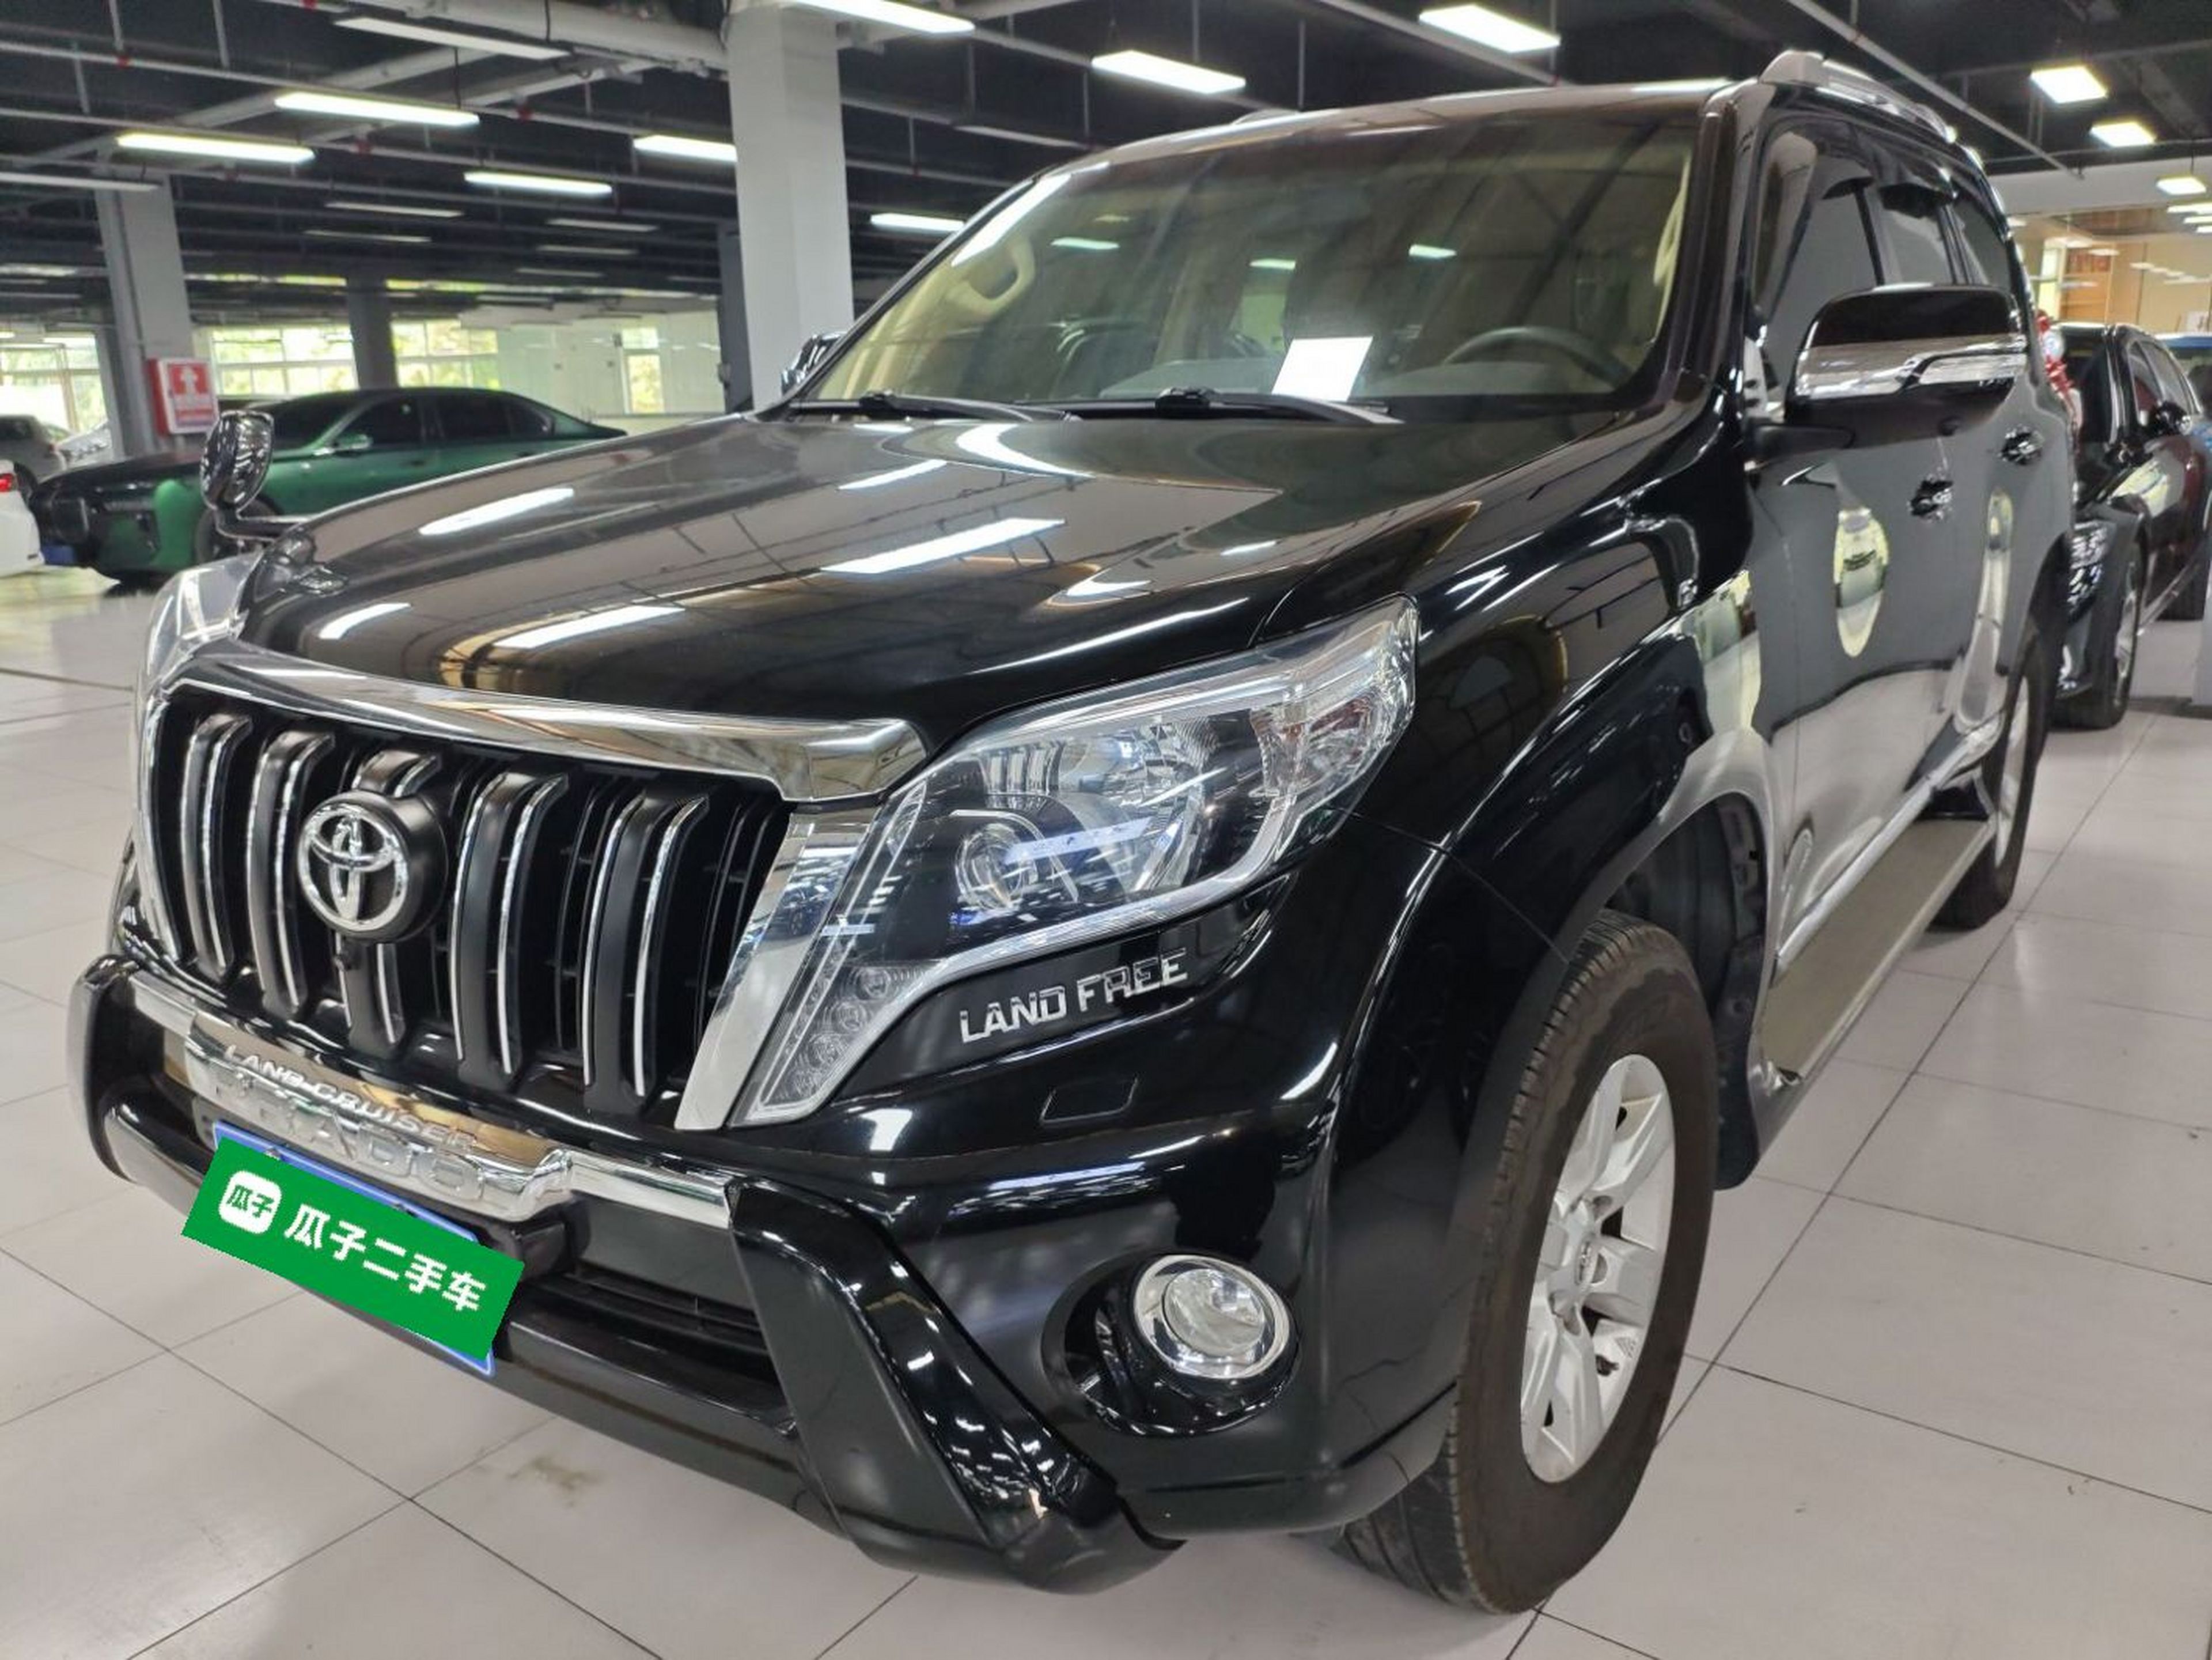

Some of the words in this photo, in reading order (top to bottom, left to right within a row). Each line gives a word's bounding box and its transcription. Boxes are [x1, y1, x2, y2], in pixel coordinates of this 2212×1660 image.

[960, 985, 1067, 1043] LAND
[1077, 947, 1188, 1012] FREE
[224, 1044, 304, 1088] LAND
[312, 1082, 477, 1152] CRUISER
